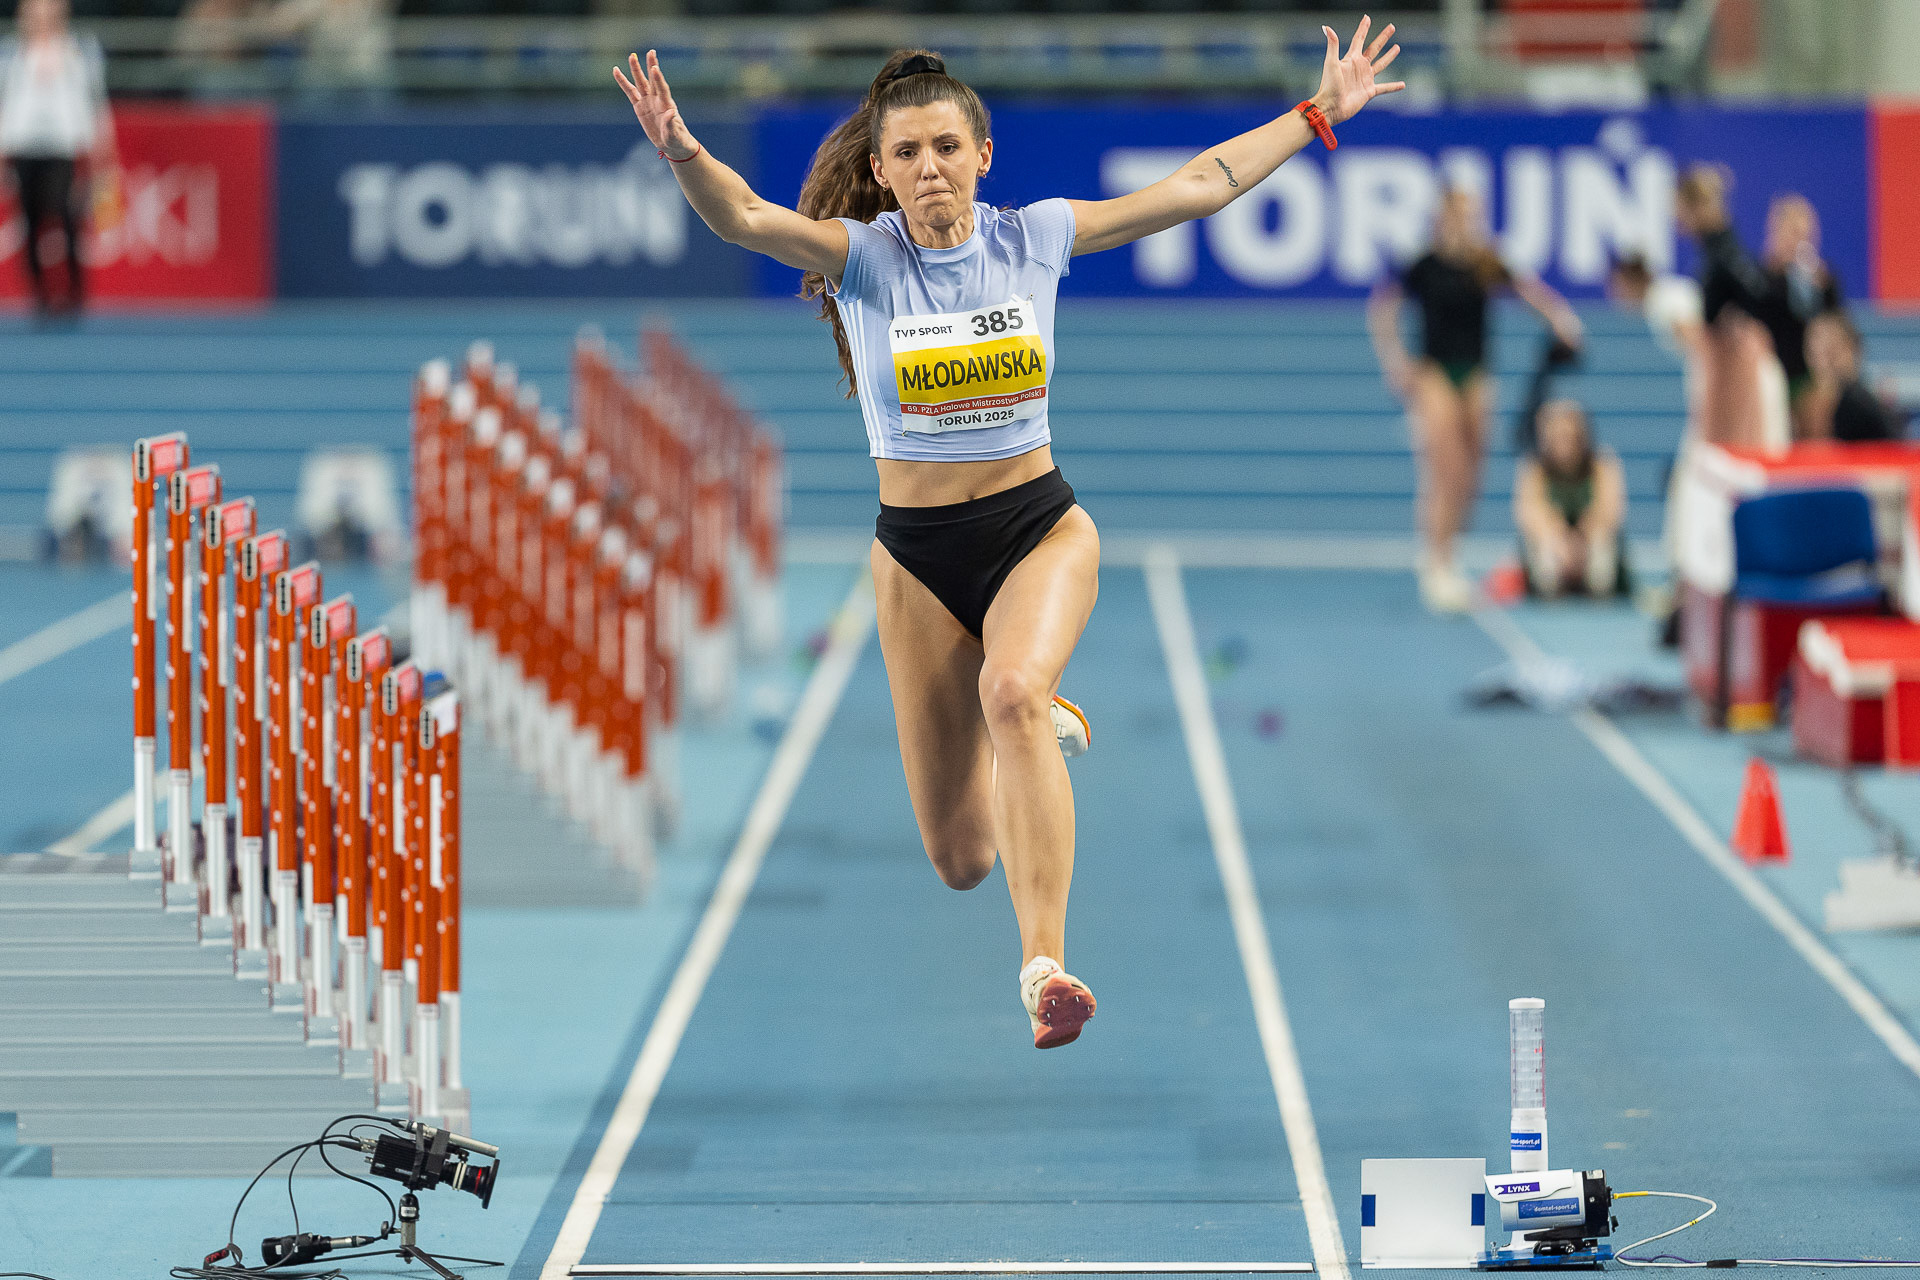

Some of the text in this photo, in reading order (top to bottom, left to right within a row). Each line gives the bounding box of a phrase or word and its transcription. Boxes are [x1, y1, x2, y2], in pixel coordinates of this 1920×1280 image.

[1100, 118, 1678, 287] TORUŃ
[895, 325, 953, 338] TVP SPORT
[970, 308, 1024, 336] 385
[901, 348, 1043, 391] MŁODAWSKA
[921, 406, 939, 414] PZLA
[940, 402, 971, 412] Halowe
[971, 395, 1019, 407] Mistrzostwa
[1020, 390, 1042, 400] Polski
[937, 409, 1015, 427] TORUŃ 2025
[1507, 1184, 1531, 1193] LYNX
